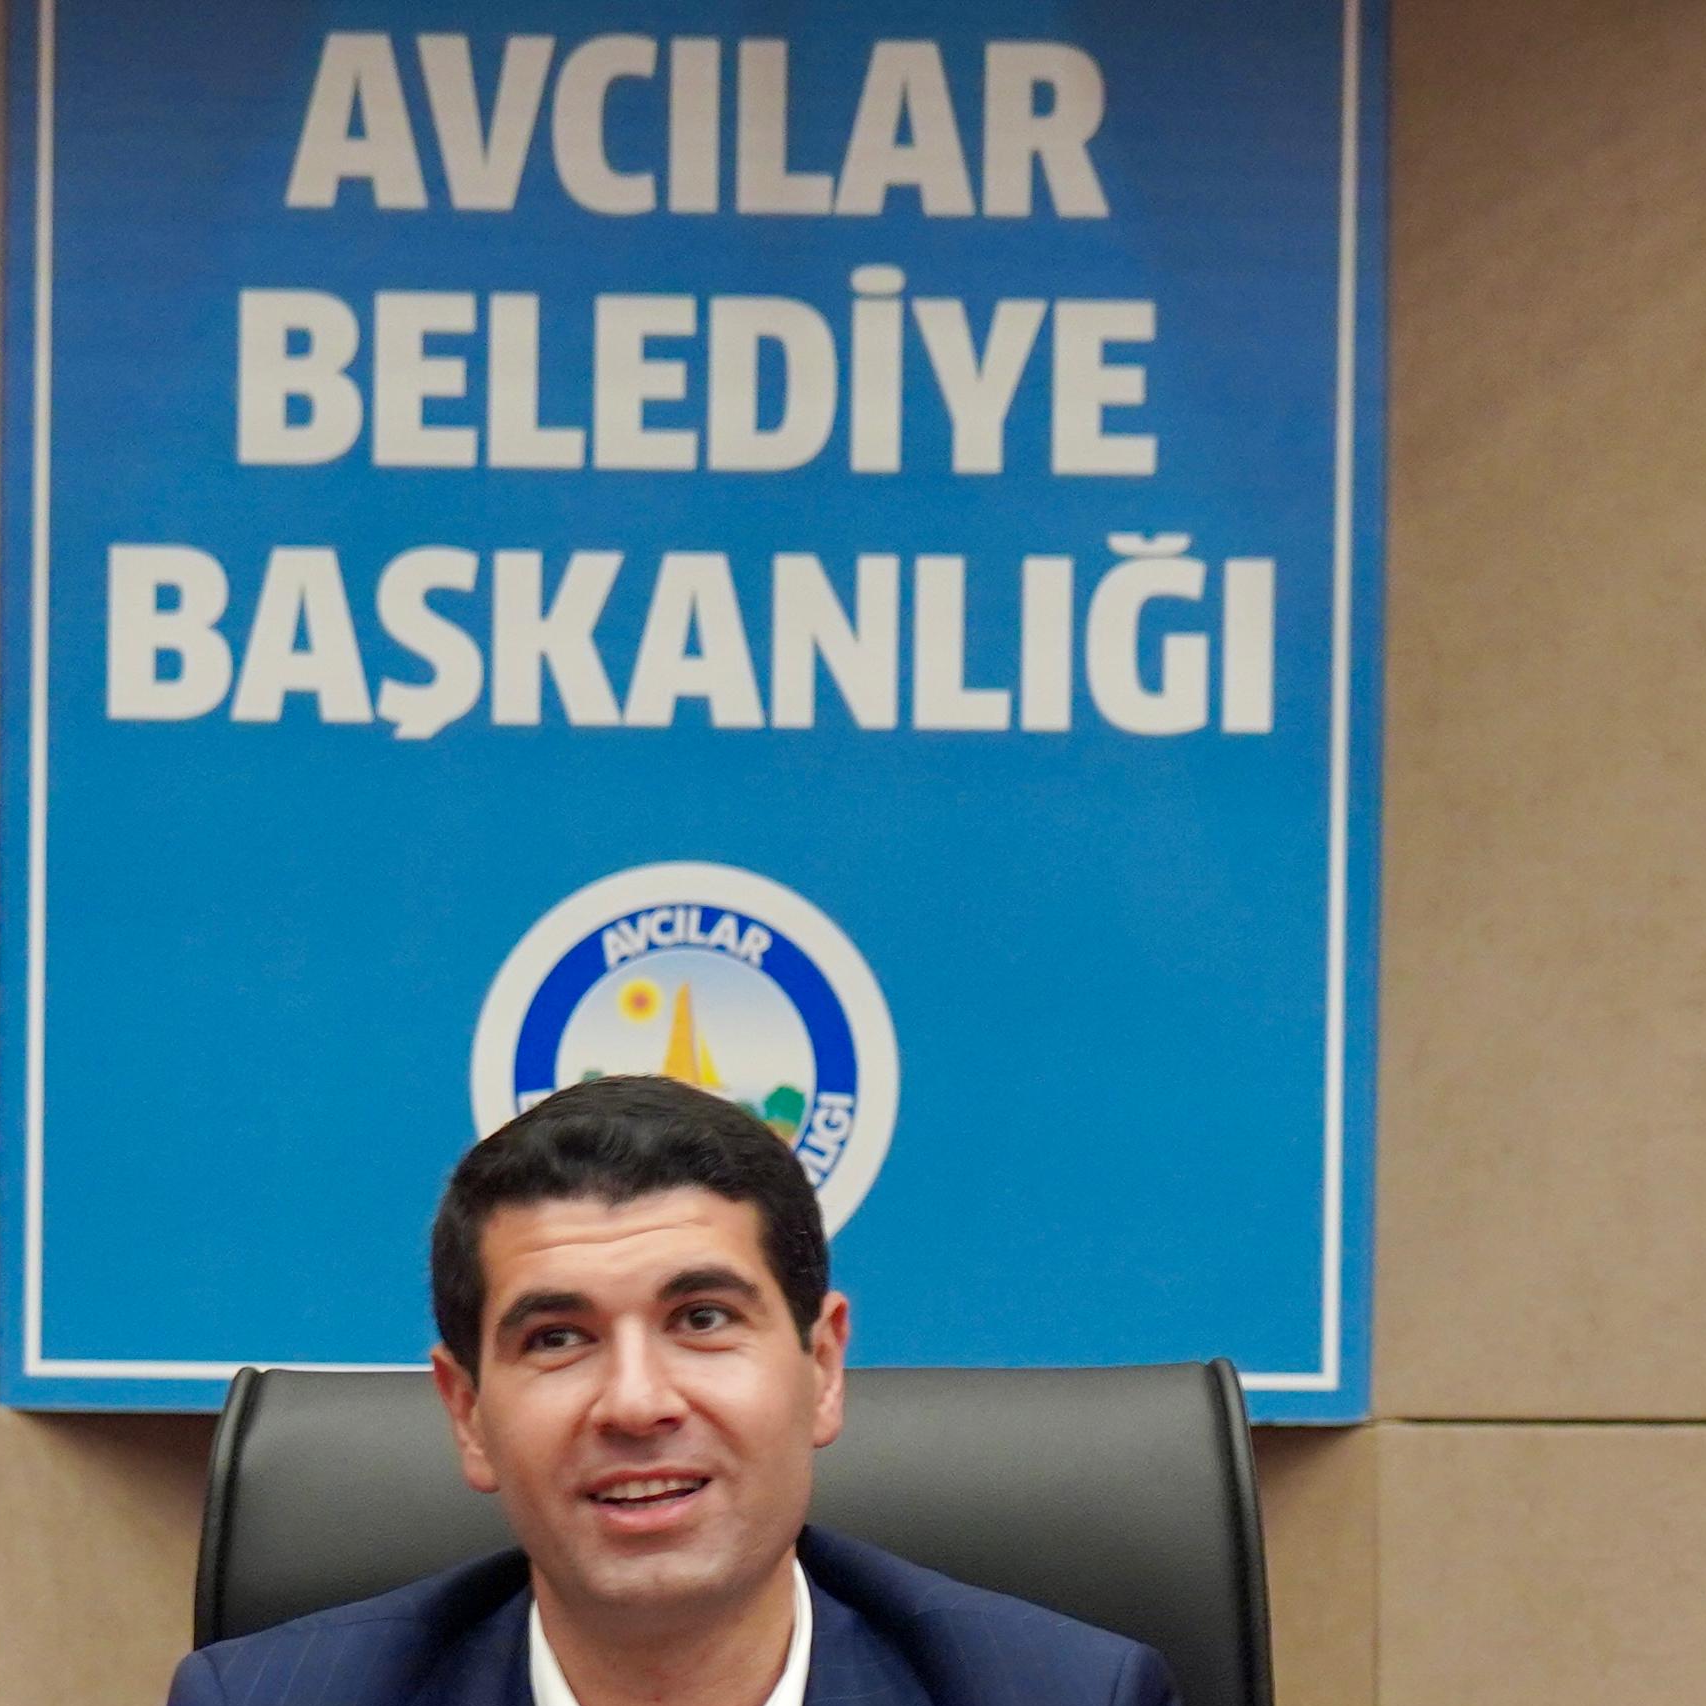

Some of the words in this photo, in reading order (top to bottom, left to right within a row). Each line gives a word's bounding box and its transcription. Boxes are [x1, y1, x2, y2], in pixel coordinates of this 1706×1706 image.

[285, 32, 1109, 219] AVCILAR
[236, 265, 1157, 476] BELEDİYE
[106, 532, 1275, 740] BAŞKANLIĞI
[602, 906, 773, 970] AVCILAR
